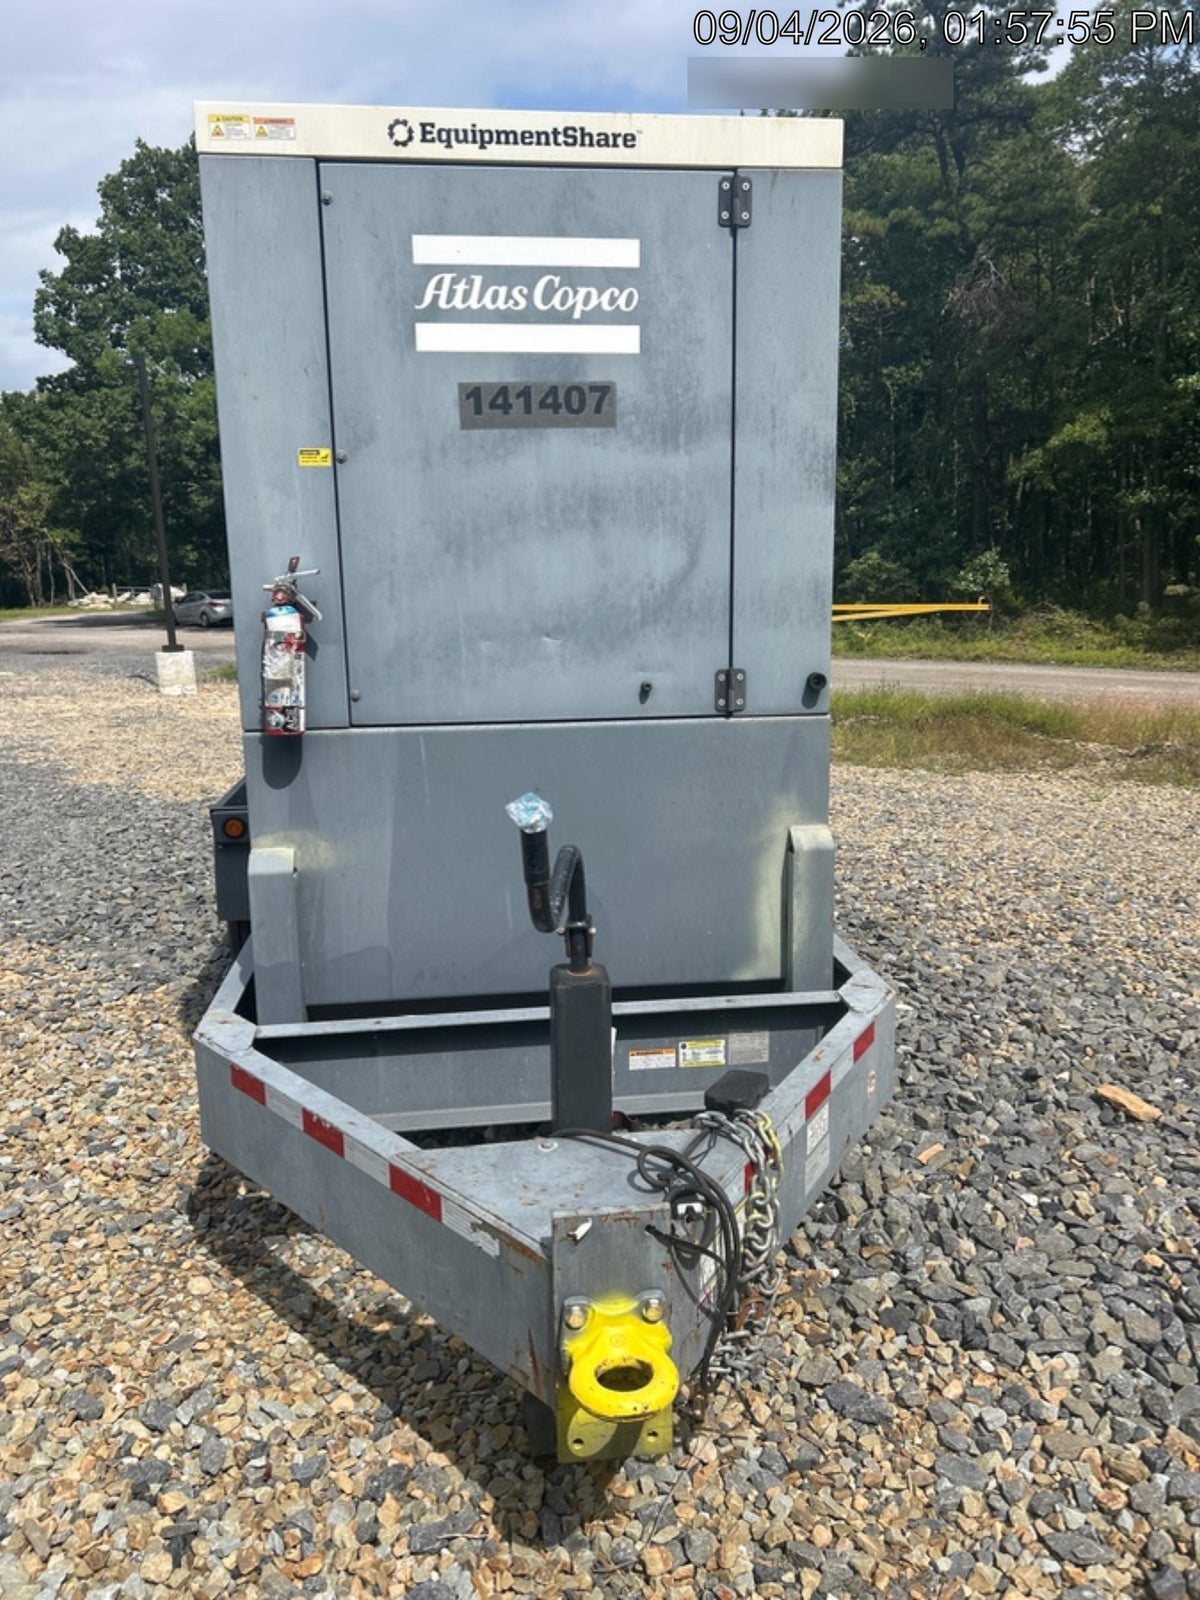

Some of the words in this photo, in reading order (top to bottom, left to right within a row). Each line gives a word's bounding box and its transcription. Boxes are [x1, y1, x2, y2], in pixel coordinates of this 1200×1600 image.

[420, 122, 637, 150] EquipmentShare
[415, 272, 529, 311] Atlas
[533, 274, 639, 320] Copco
[465, 384, 612, 417] 141407
